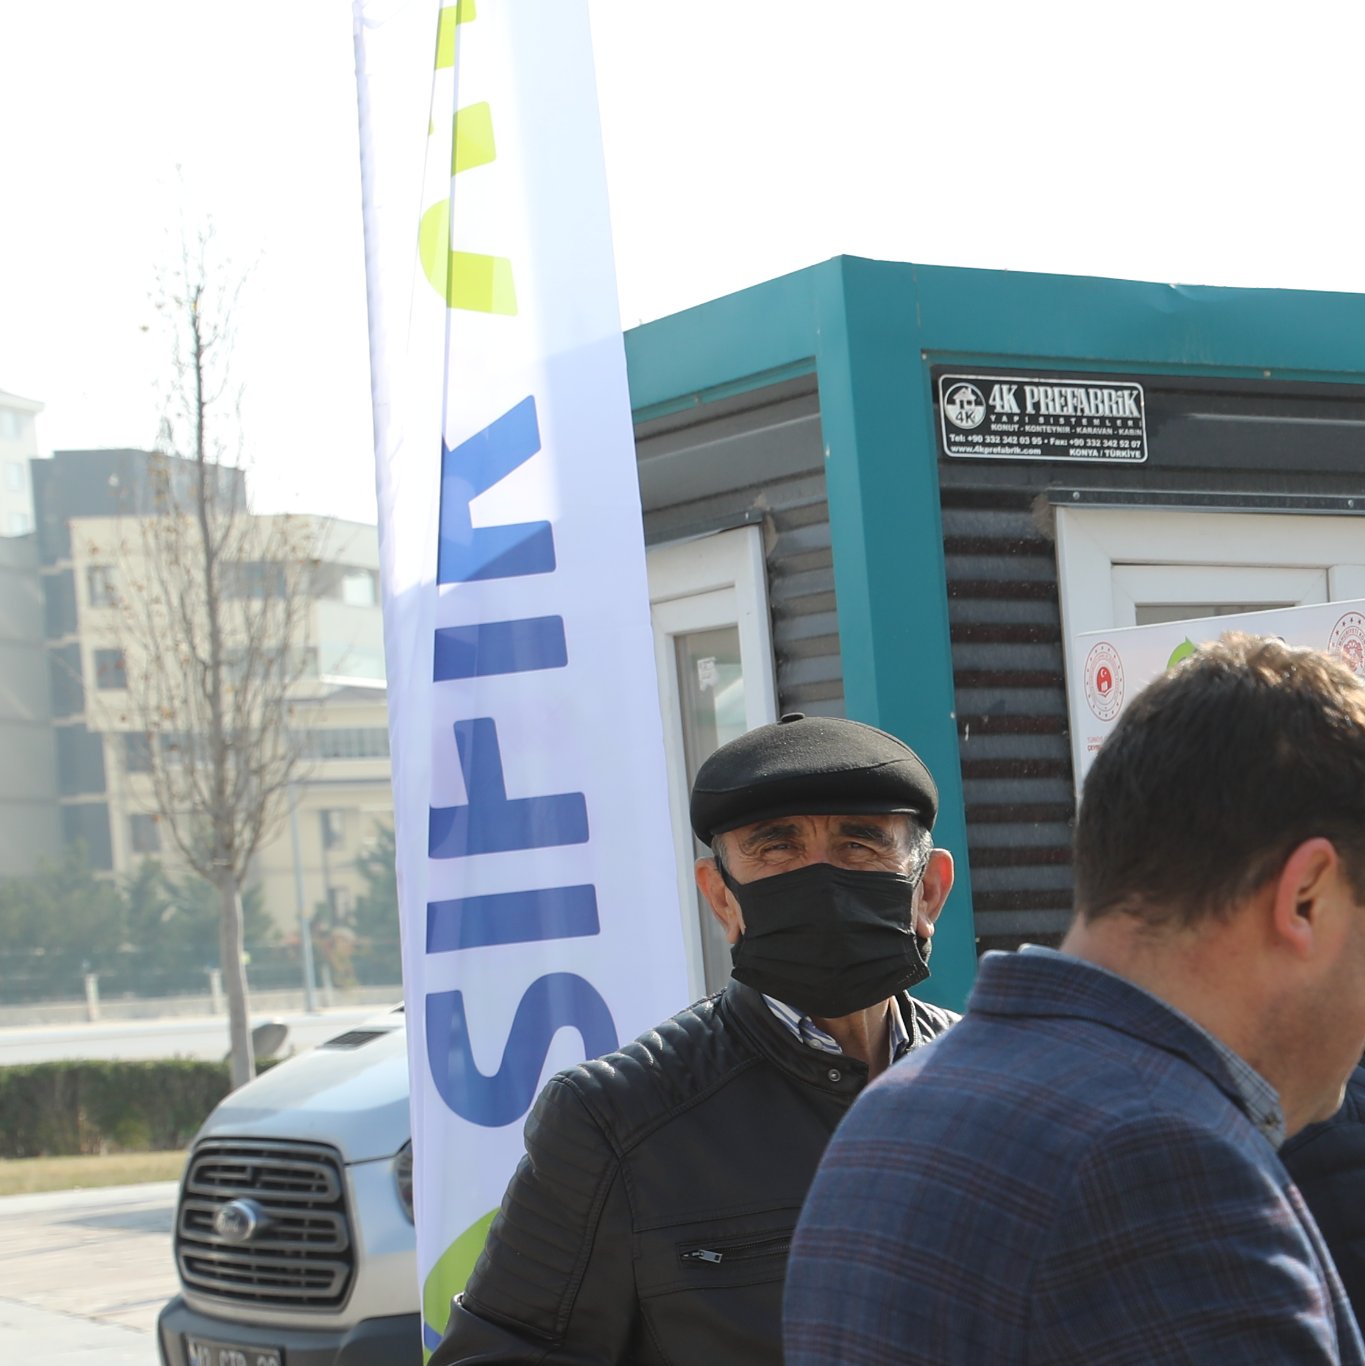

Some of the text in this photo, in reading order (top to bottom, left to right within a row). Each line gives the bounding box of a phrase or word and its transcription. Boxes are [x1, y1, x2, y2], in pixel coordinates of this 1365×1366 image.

[988, 384, 1021, 414] 4K
[955, 411, 976, 424] 4K
[984, 436, 1001, 444] 332
[1086, 439, 1101, 447] 332
[1069, 448, 1099, 457] KONYA
